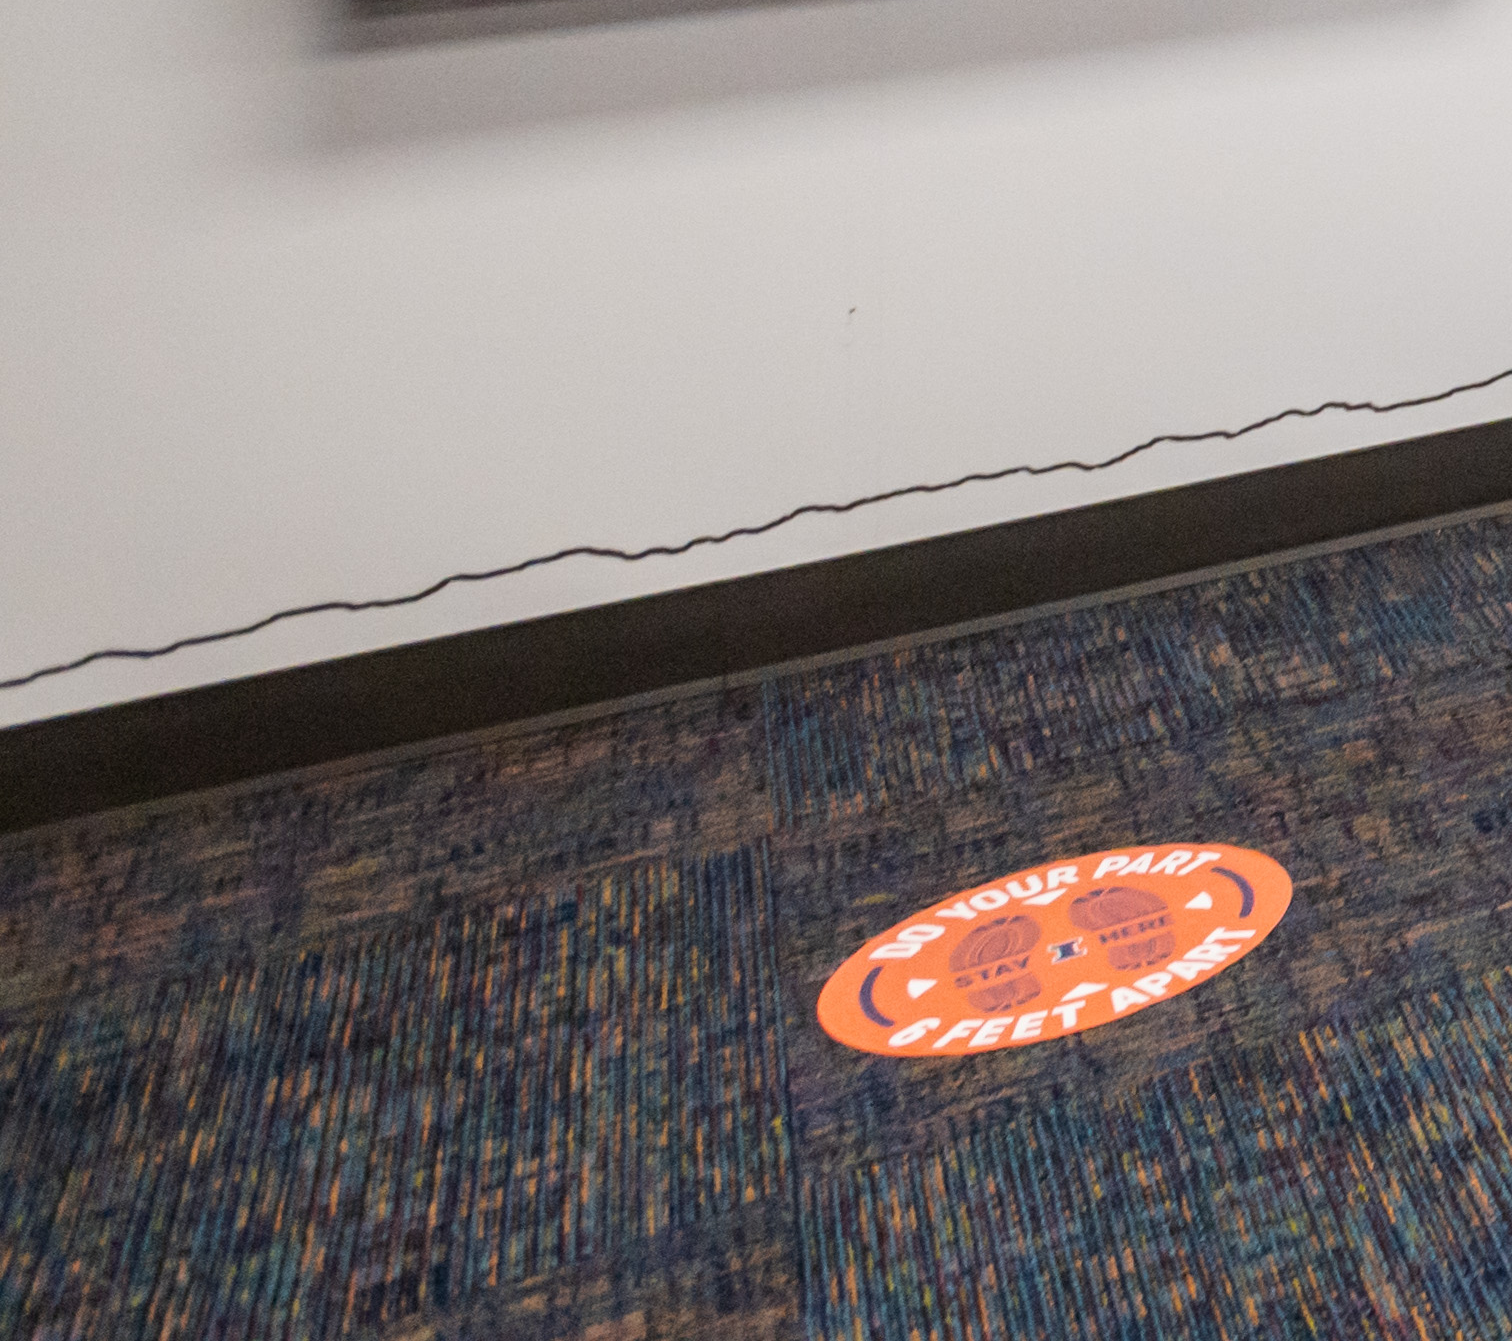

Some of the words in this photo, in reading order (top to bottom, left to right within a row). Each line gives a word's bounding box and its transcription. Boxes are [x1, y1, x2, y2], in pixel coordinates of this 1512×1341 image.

[869, 923, 945, 960] DO
[936, 865, 1079, 920] YOUR
[1093, 850, 1222, 879] PART
[888, 1017, 942, 1048] 6
[933, 1000, 1087, 1050] FEET
[1110, 927, 1257, 1013] APART
[954, 955, 1030, 989] STAY
